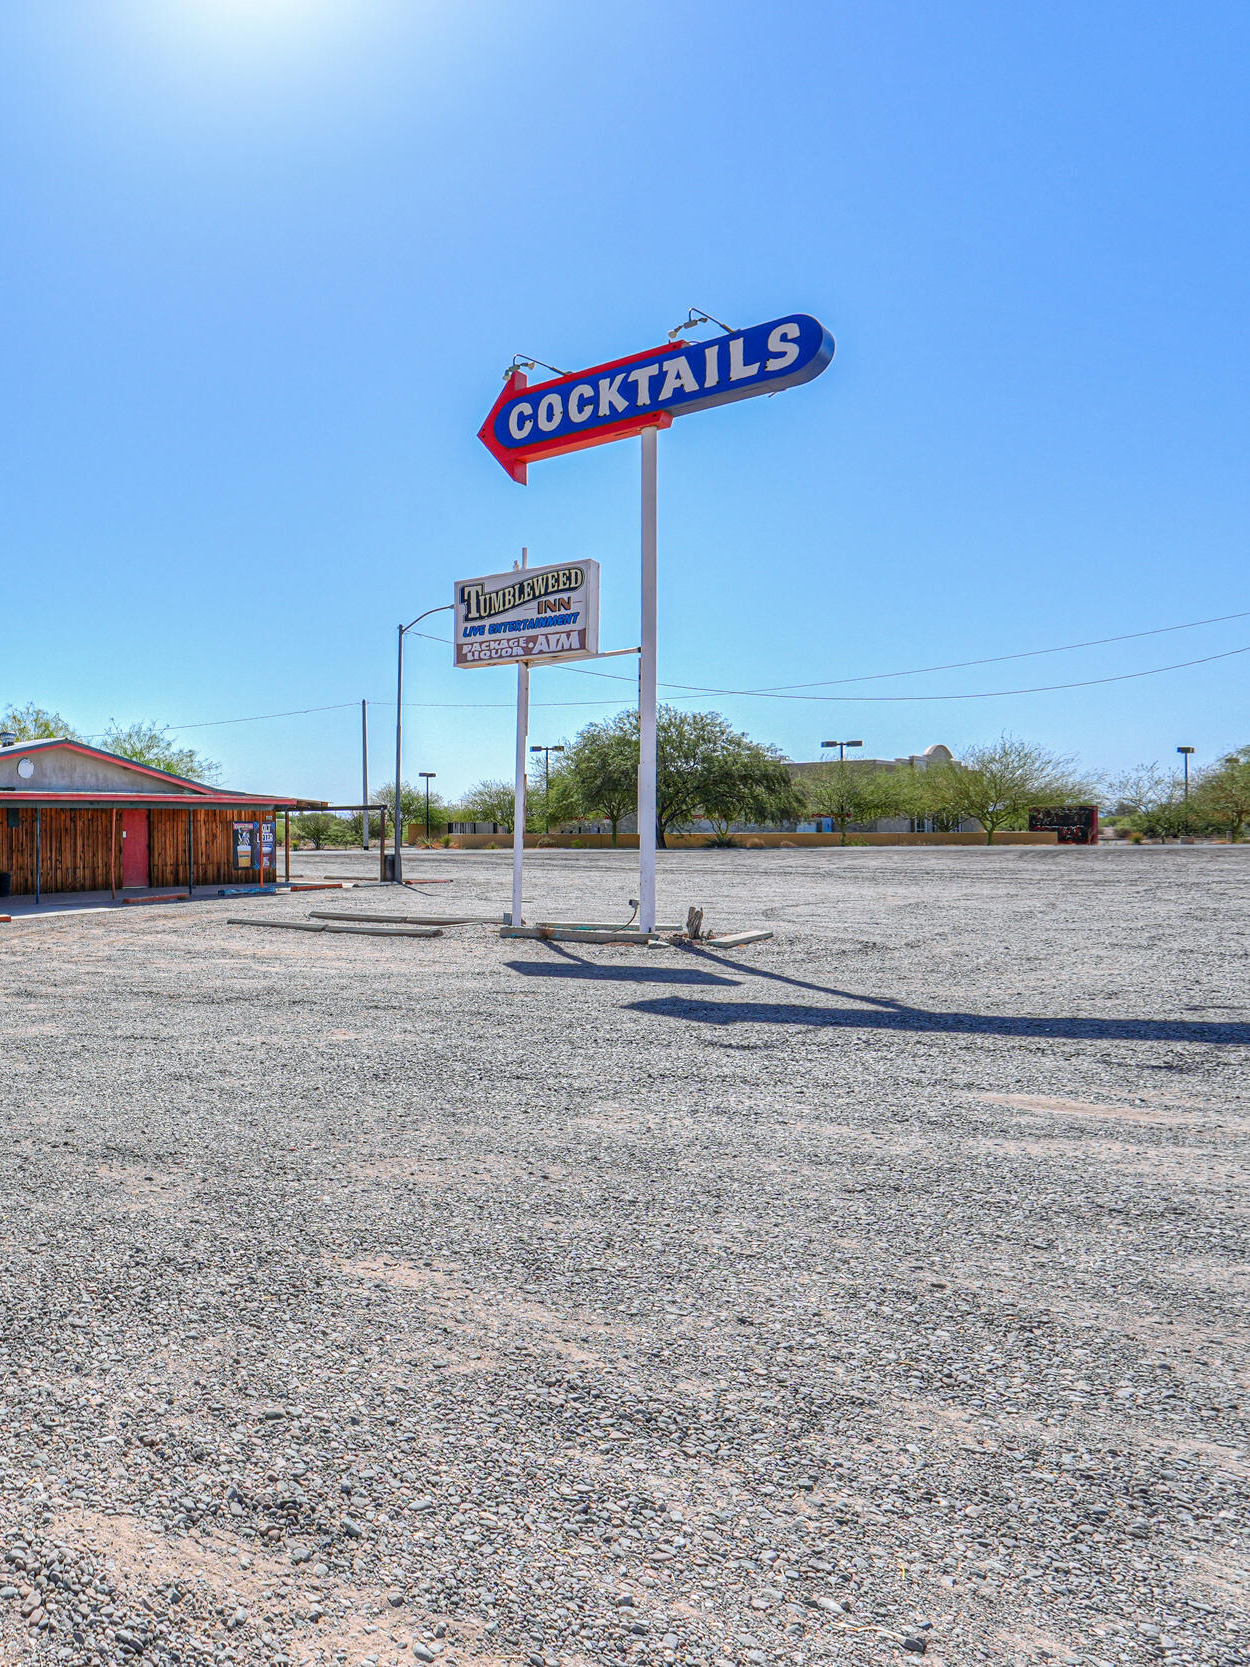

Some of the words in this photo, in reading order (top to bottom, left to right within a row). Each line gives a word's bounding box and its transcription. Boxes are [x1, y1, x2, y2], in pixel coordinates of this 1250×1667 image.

[508, 322, 800, 440] COCKTAILS
[463, 568, 583, 619] TUMBLEWEED
[538, 597, 572, 614] INN
[463, 624, 486, 637] LIVE
[488, 612, 580, 635] ENTERTAINMENT
[462, 637, 527, 654] PACKAGE
[466, 646, 524, 661] LIQUOR
[532, 631, 581, 654] ATM
